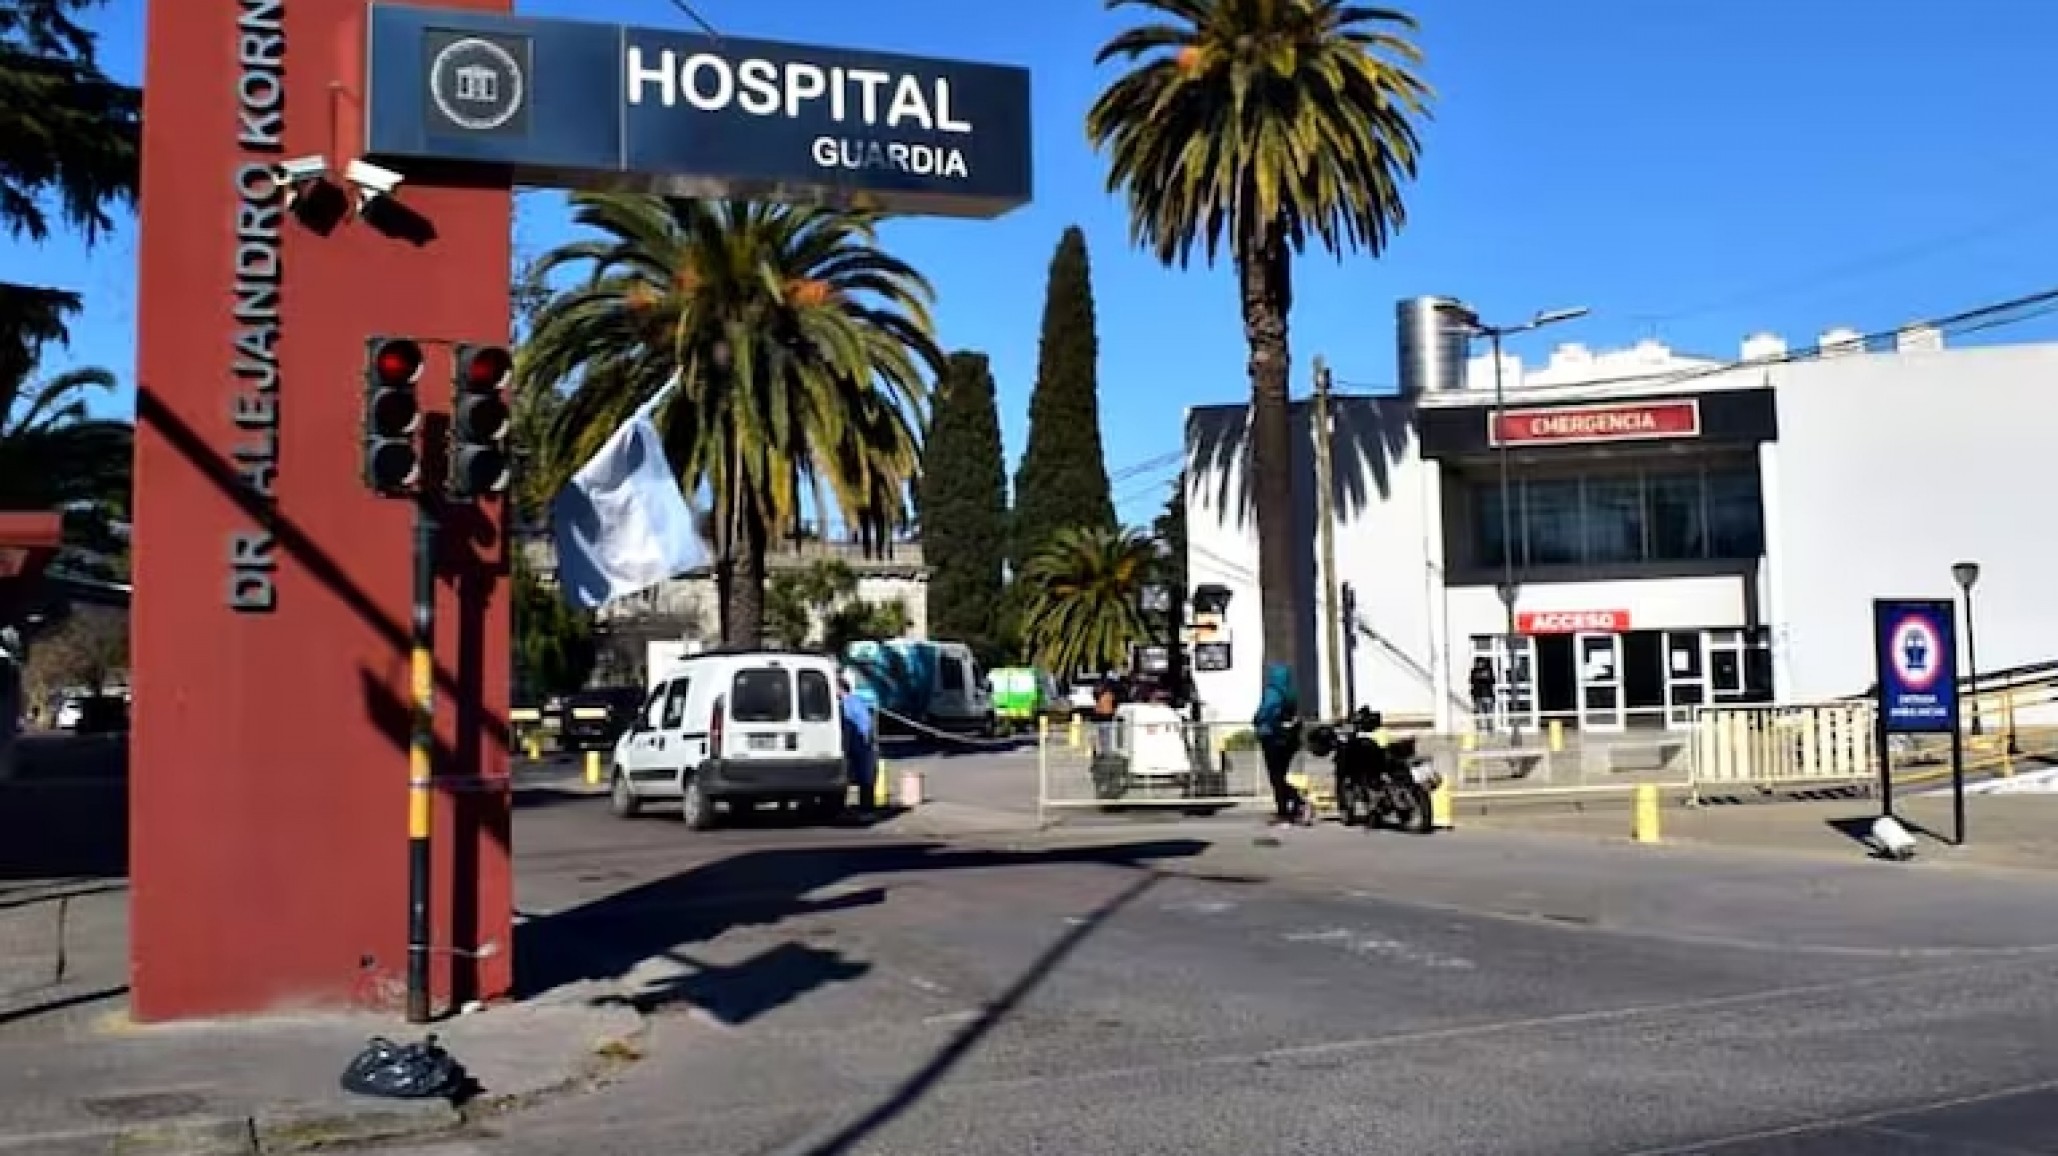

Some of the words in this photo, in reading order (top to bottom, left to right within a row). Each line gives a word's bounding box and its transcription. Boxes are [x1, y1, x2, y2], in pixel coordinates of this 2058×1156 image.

[628, 46, 972, 133] HOSPITAL
[811, 136, 968, 178] GUARDIA
[232, 163, 279, 500] ALEJANDRO
[1531, 412, 1656, 435] EMERGENCIA
[230, 531, 273, 607] DR
[1533, 612, 1615, 630] ACCESO
